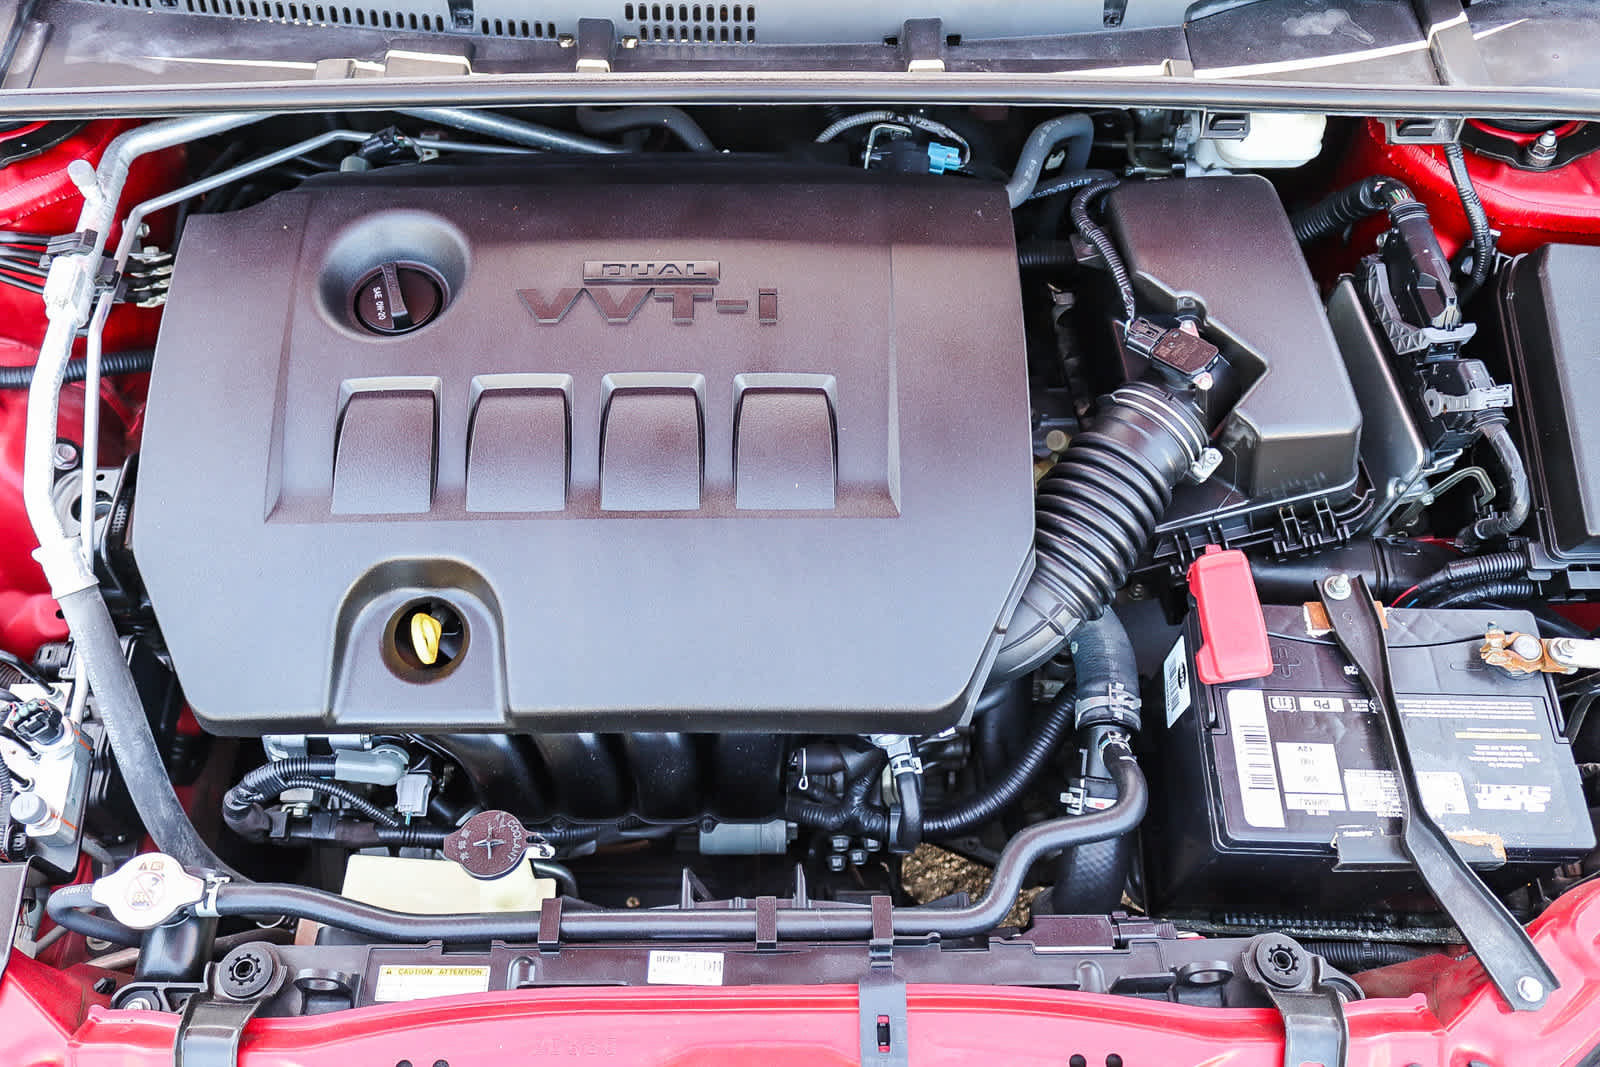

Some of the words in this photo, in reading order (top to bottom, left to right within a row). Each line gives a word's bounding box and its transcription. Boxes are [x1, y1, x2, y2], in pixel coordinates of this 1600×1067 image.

[602, 263, 707, 275] DUAL
[373, 286, 383, 299] SAE
[375, 301, 387, 320] 0W-20
[516, 288, 778, 325] VVT-i
[1314, 700, 1330, 709] Pb
[506, 819, 522, 862] COOLANT
[398, 968, 433, 976] CAUTION
[439, 968, 483, 976] ATTENTION
